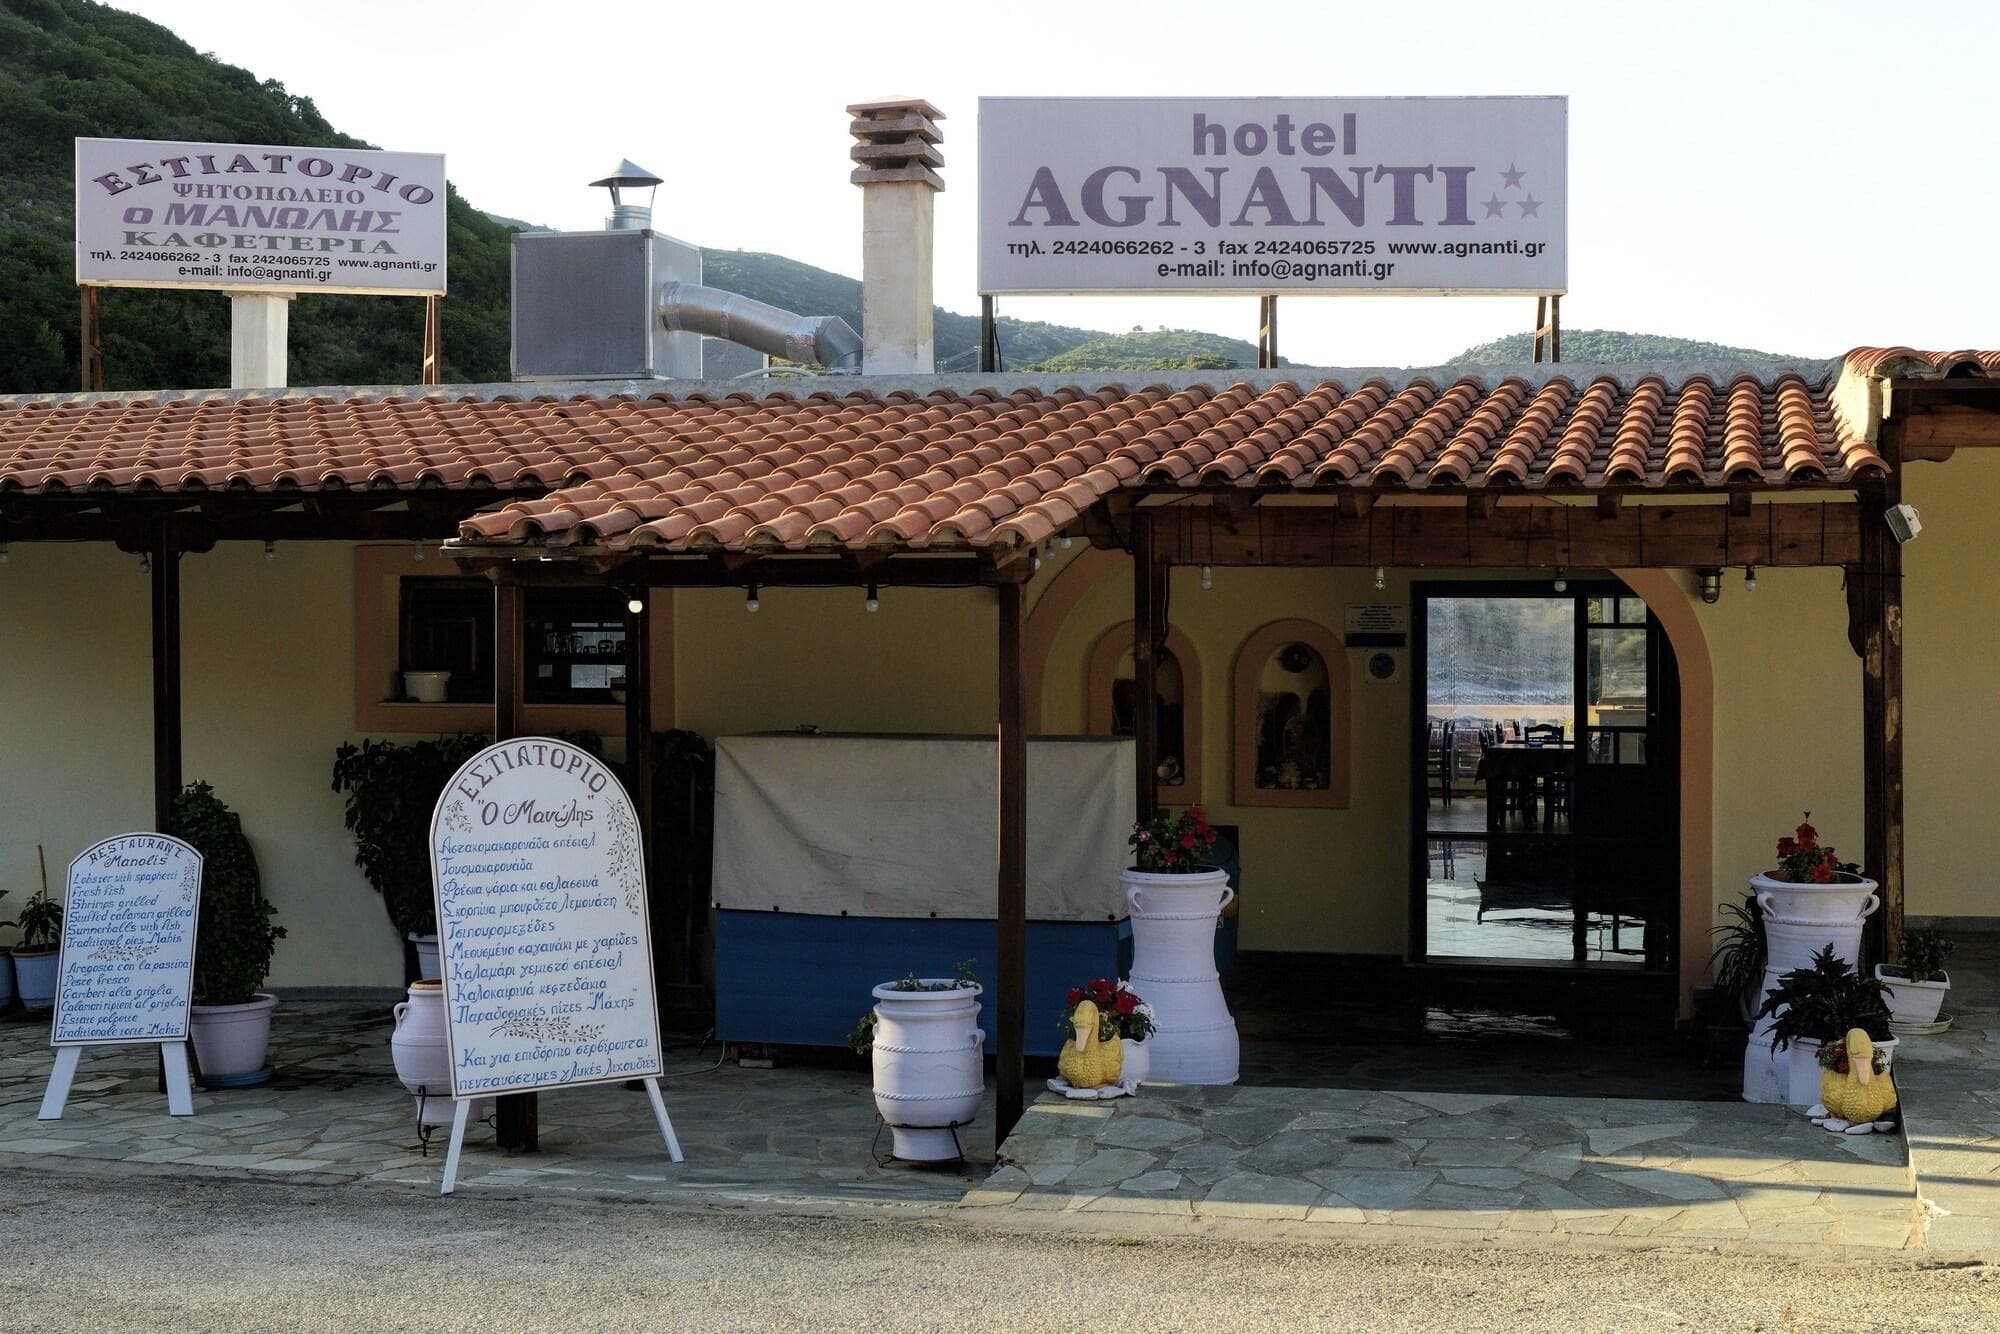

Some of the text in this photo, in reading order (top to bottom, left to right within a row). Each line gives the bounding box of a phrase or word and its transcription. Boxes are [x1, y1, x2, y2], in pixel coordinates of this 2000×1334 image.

[1192, 113, 1358, 156] hotel
[92, 153, 435, 205] ΕΣΤΙΑΤΟΡΙΟ
[172, 182, 365, 205] ΨΗΤΟΠΩΛΕΙΟ
[1008, 165, 1476, 228] AGNANTI
[164, 203, 402, 234] ΜΑΝΩΛΗΣ
[122, 231, 398, 255] ΚΑΦΕΤΕΡΙΑ
[1007, 242, 1046, 258] τηλ.
[1053, 240, 1175, 255] 2424066262
[1194, 240, 1206, 255] 3
[1218, 239, 1249, 255] fax
[1254, 240, 1376, 255] 2424065725
[1388, 239, 1547, 258] www.agnanti.gr
[90, 252, 116, 262] τηλ.
[120, 251, 200, 262] 2424066262
[212, 254, 221, 263] 3
[228, 253, 249, 264] fax
[252, 254, 330, 266] 2424065725
[338, 259, 438, 272] www.agnanti.gr
[1157, 259, 1395, 281] e-mail: info@agnanti.gr
[178, 265, 333, 281] e-mail: info@agnanti.gr
[457, 744, 608, 801] ΕΣΤΙΑΤΟΡΙΟ
[88, 838, 185, 866] RESTAURANT
[438, 832, 597, 855] Αστακομακαρονάδα σπέσιαλ
[441, 857, 534, 876] Τονομακαρονάδα
[72, 871, 178, 885] Lobster with spaghetti
[442, 874, 599, 898] Φρέσκα ψάρια και θαλασσινά
[71, 885, 125, 898] Fresh fish
[69, 910, 108, 923] Stuffed
[156, 905, 194, 920] grilled
[71, 895, 159, 911] Shrimps grilled
[442, 893, 617, 918] Σκορπίνα μπουρδέτο λεμονάτη
[140, 922, 158, 931] with
[161, 920, 181, 930] fish
[447, 920, 556, 940] Τσιπουρομεζέδες
[67, 935, 124, 949] Traditional
[125, 936, 144, 945] pies
[447, 942, 515, 960] Μεθυσμένο
[575, 939, 589, 953] με
[592, 933, 638, 953] γαρίδες
[117, 963, 135, 972] con
[138, 960, 150, 970] la
[449, 951, 622, 983] Καλαμάρι γεμιστό σπέσιαλ
[63, 974, 130, 987] Pesce fresco
[451, 977, 608, 1004] Καλοκαιρινά κεφτεδάκια
[62, 984, 173, 1000] Gamberi alla griglia
[135, 998, 148, 1008] al
[148, 996, 186, 1012] griglia
[452, 1005, 545, 1026] Παραδοσιακές
[551, 1001, 582, 1014] πίτες
[61, 1014, 96, 1025] Estate
[58, 1025, 117, 1038] Traditionale
[120, 1026, 144, 1035] torte
[457, 1037, 649, 1068] Και για επιδόρπιο σερβίρονται
[459, 1054, 657, 1090] πεντανόστιμες γλυκές λιχουδιές
